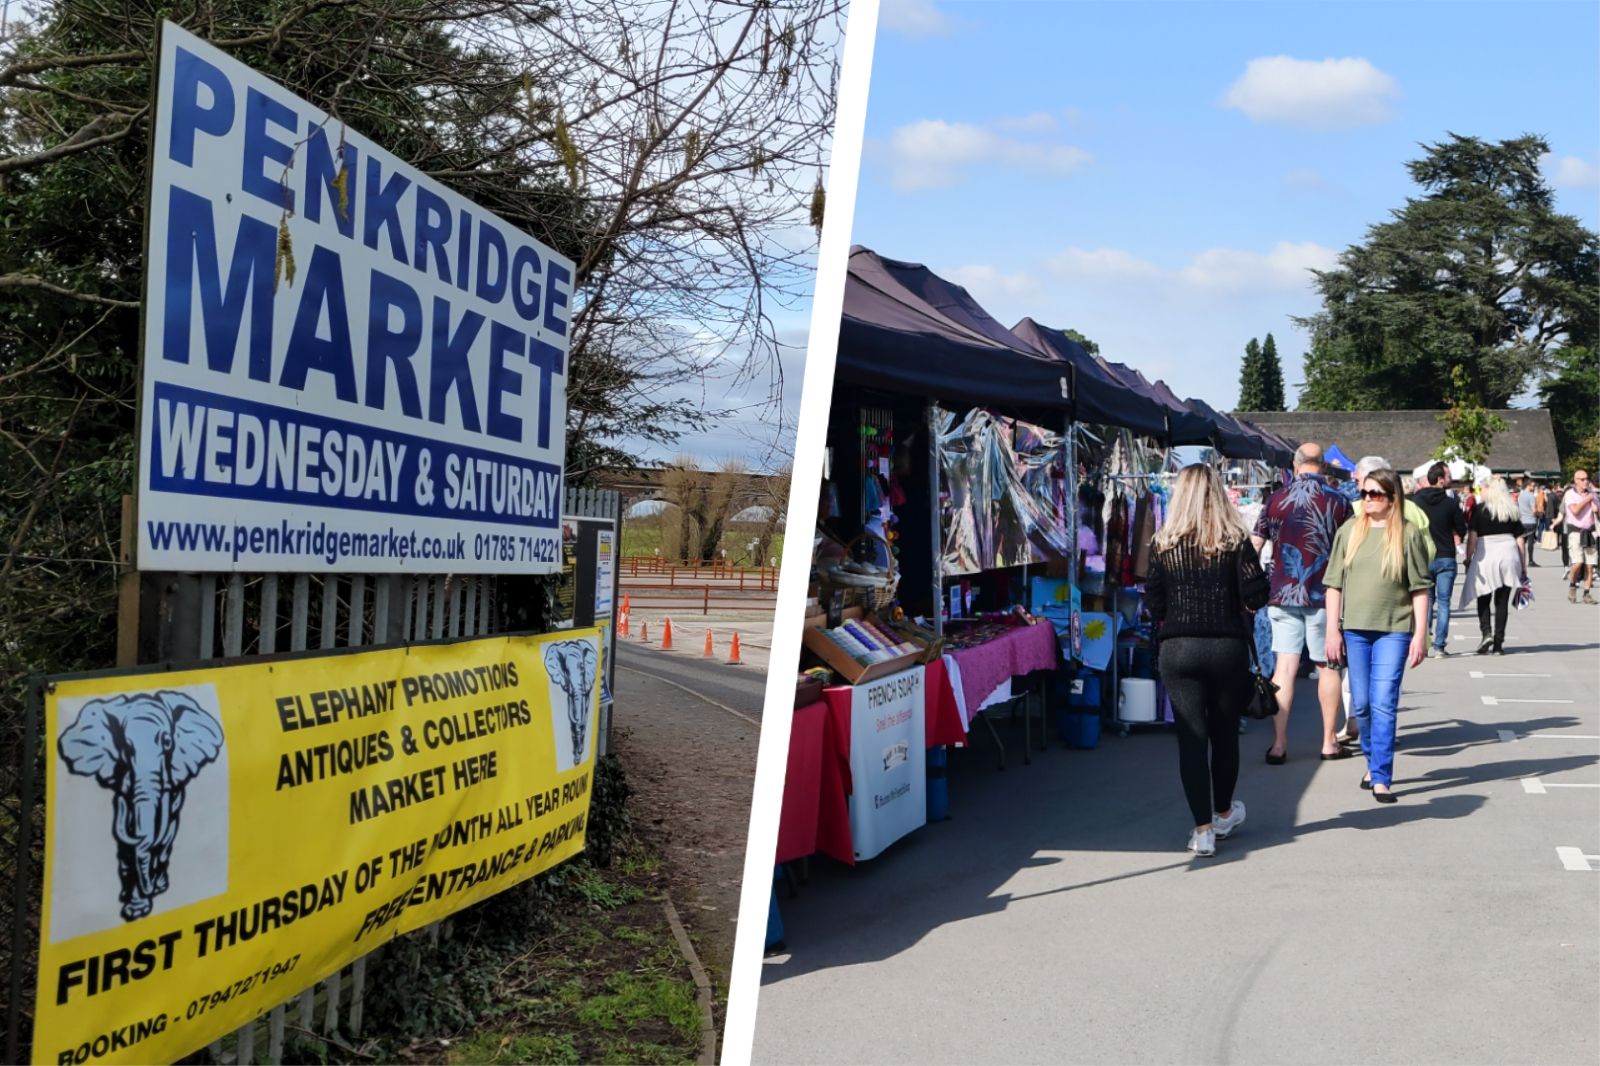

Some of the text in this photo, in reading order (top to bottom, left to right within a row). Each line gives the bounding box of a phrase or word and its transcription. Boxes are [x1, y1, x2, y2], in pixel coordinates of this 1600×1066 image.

[169, 45, 571, 337] PENKRIDGE
[163, 184, 564, 450] MARKET
[158, 398, 560, 519] WEDNESDAY & SATURDAY
[147, 518, 465, 566] www.penkridgemarket.co.uk
[474, 533, 515, 562] 01785
[519, 536, 560, 563] 714221
[275, 661, 519, 733] ELEPHANT PROMOTIONS
[868, 681, 896, 710] FRENCH
[275, 699, 531, 791] ANTIQUES & COLLECTORS
[349, 750, 497, 825] MARKET HERE
[56, 930, 182, 1006] FIRST
[194, 869, 348, 958] THURSDAY
[355, 855, 383, 894] OF
[389, 838, 427, 879] THE
[496, 802, 523, 834] ALL
[526, 787, 559, 821] YEAR
[562, 772, 589, 807] ROUN
[407, 843, 526, 907] ENTRANCE
[524, 837, 538, 863] &
[538, 810, 585, 857] PARKING
[58, 1013, 167, 1066] BOOKING
[186, 954, 301, 1021] 07947271947
